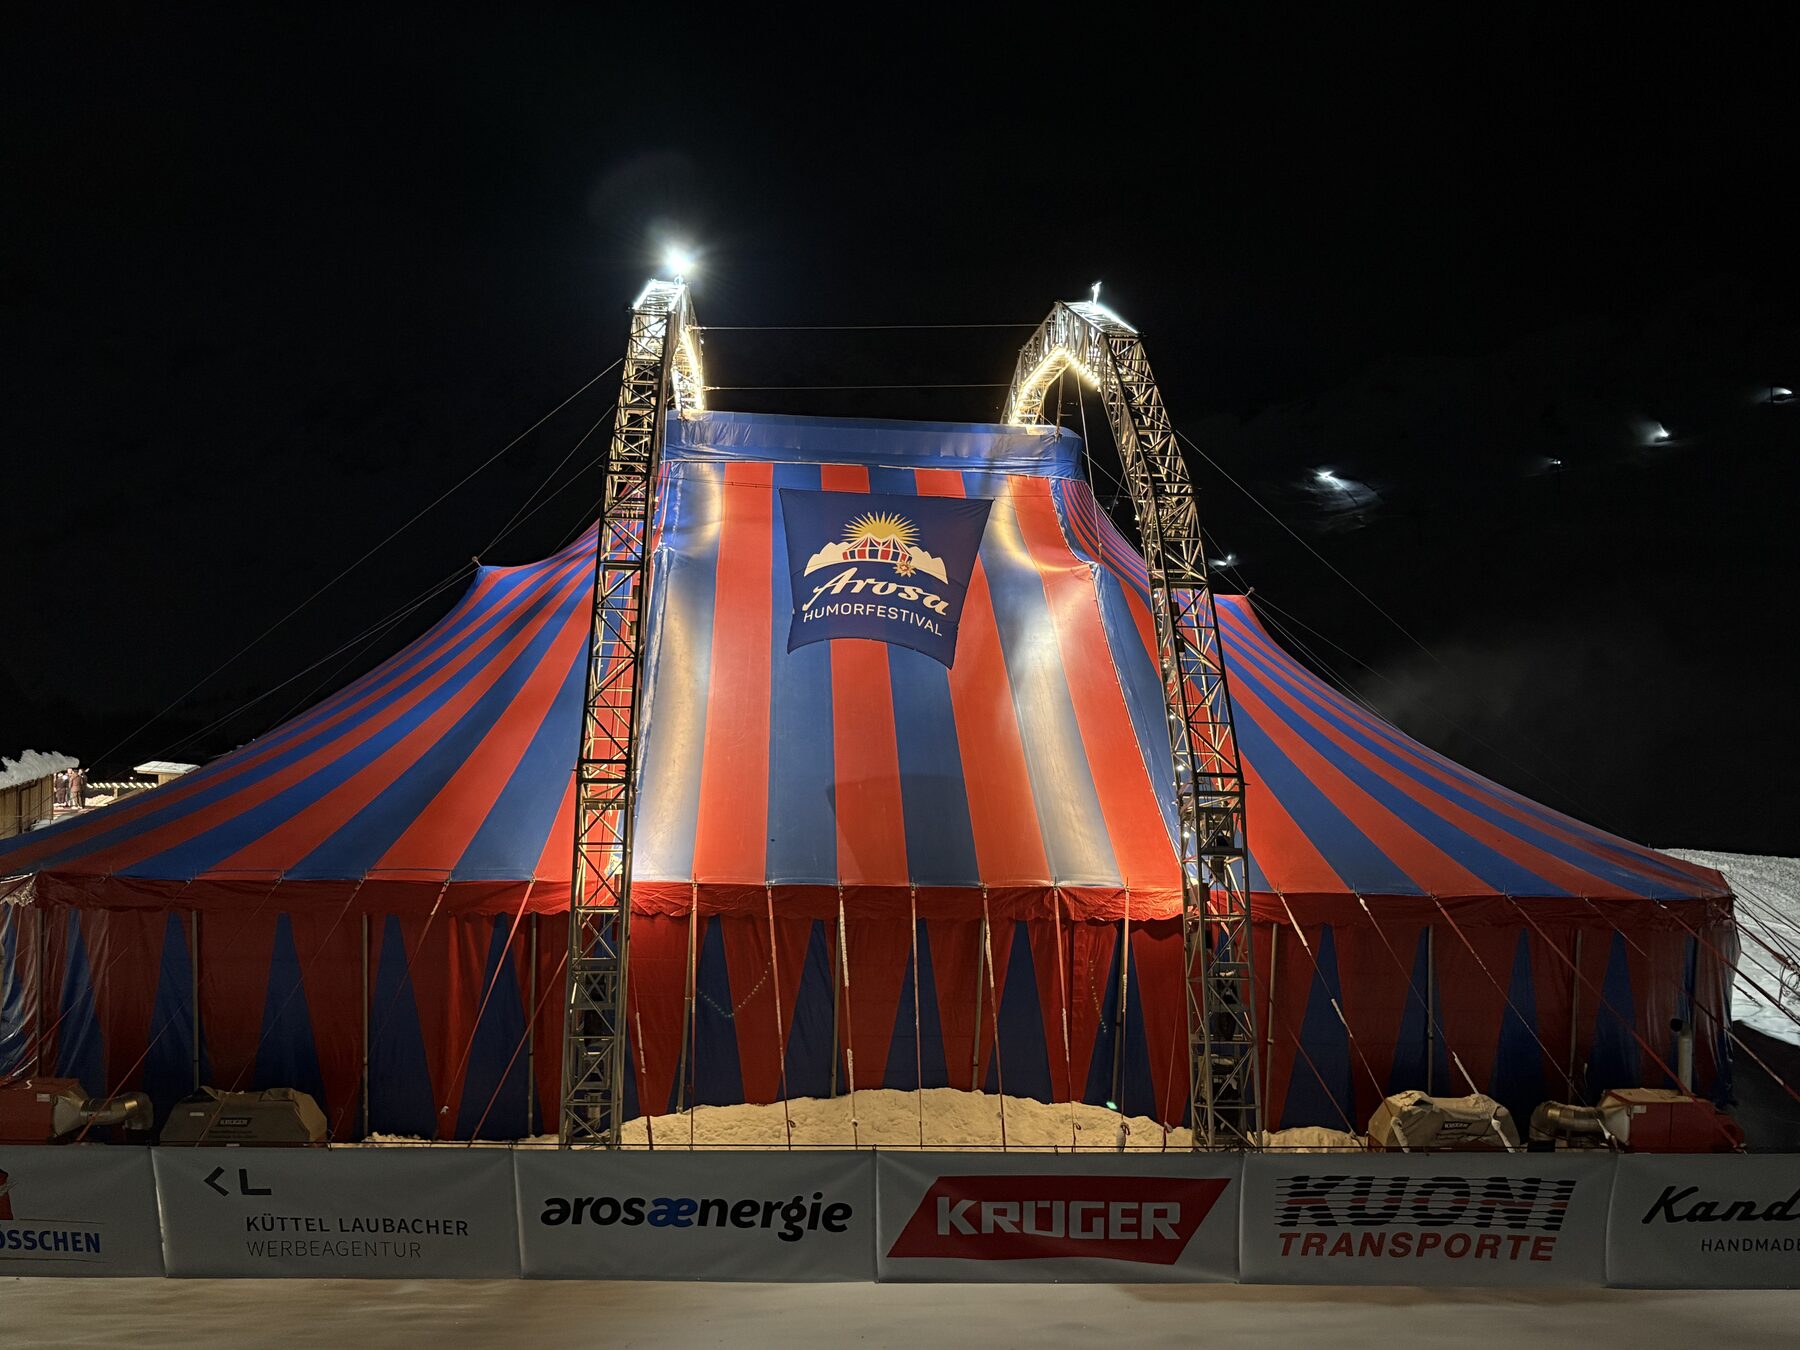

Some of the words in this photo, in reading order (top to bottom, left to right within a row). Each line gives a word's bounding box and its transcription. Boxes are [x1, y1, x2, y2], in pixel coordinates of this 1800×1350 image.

[802, 567, 949, 616] Arosa
[803, 602, 943, 637] HUMORFESTIVAL
[246, 1213, 330, 1233] KÜTTEL
[339, 1217, 469, 1236] LAUBACHER
[937, 1196, 1181, 1240] KRÜGER
[247, 1240, 421, 1258] WERBEAGENTUR
[1279, 1232, 1557, 1262] TRANSPORTE
